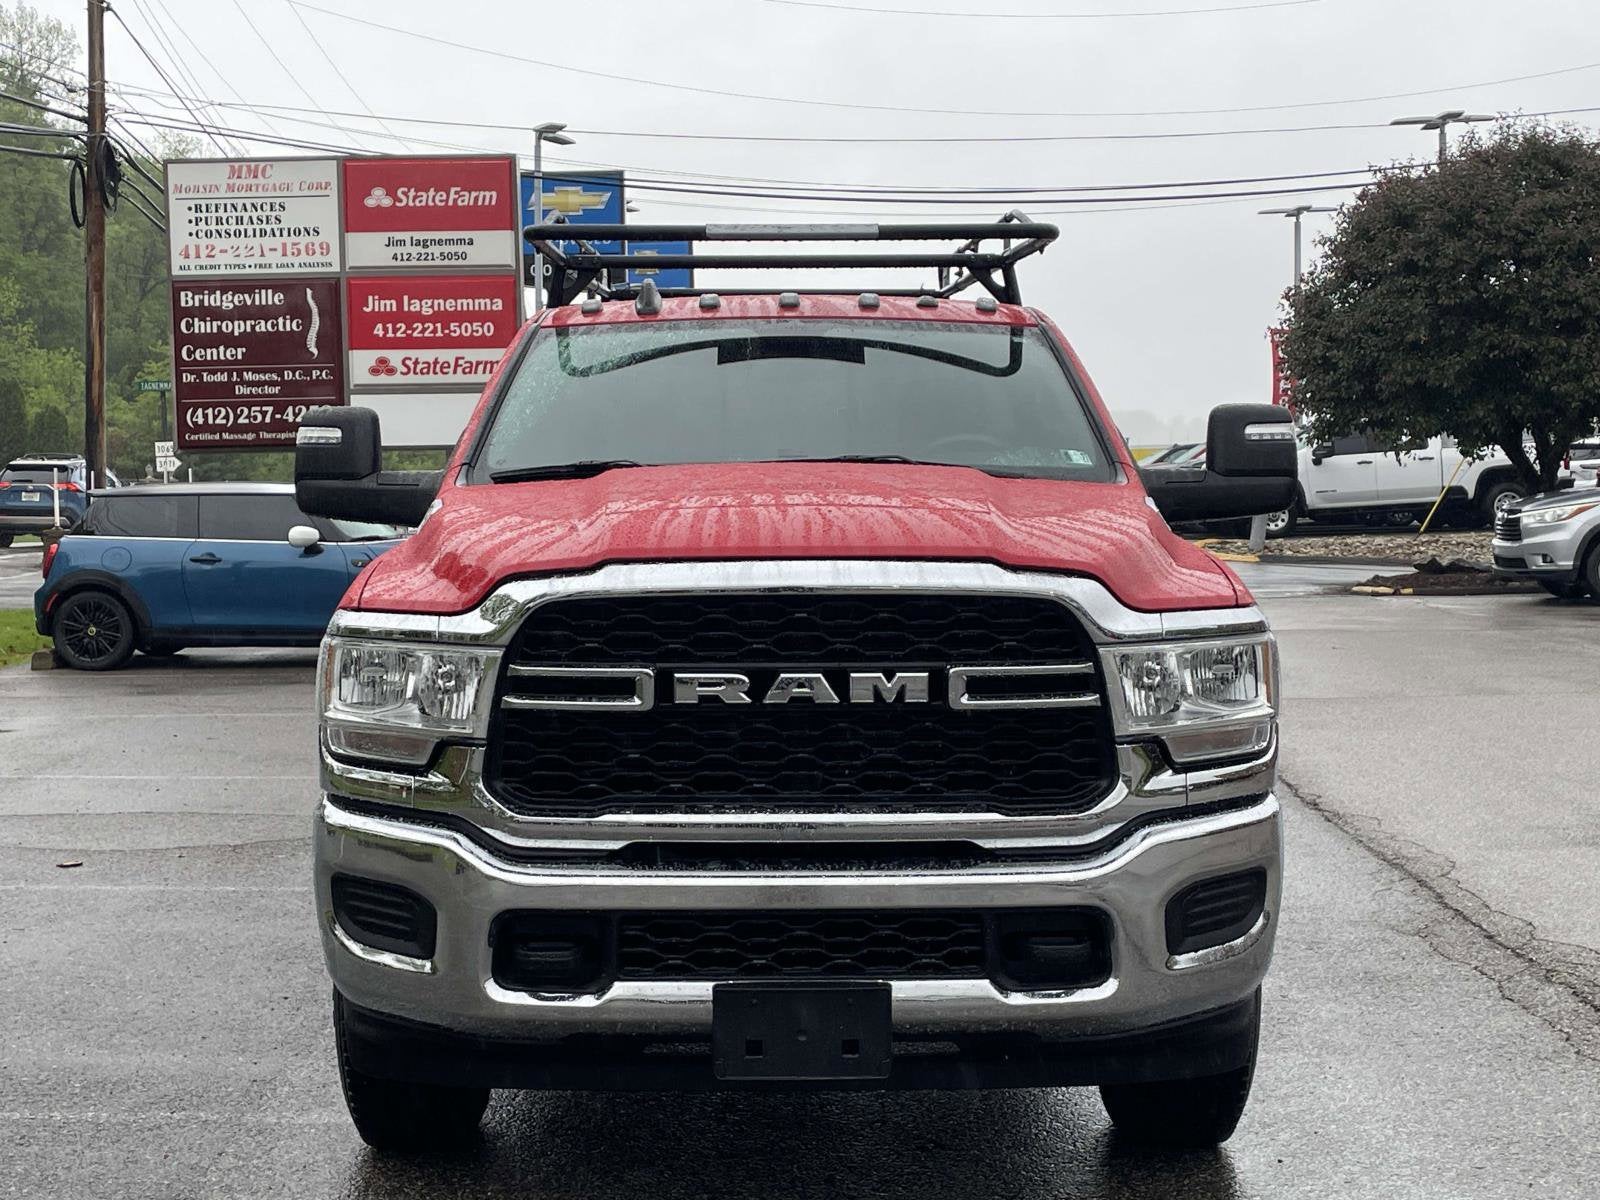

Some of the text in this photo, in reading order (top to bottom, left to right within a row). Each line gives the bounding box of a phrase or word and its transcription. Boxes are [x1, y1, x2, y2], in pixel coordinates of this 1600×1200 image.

[227, 164, 274, 180] MMC
[225, 182, 293, 194] MORTGAGE
[194, 202, 287, 214] REFINANCES
[194, 215, 282, 226] PURCHASES
[195, 226, 320, 239] CONSOLIDATIONS
[384, 236, 474, 249] Jim Iagnemma
[178, 241, 331, 260] 412-221-1569
[391, 251, 468, 262] 412-221-5050
[180, 289, 285, 310] Bridgeville
[362, 295, 503, 315] Jim Iagnemma
[180, 315, 303, 336] Chiropractic
[373, 322, 495, 338] 412-221-5050
[181, 344, 247, 361] Center
[182, 372, 199, 383] Dr.
[201, 371, 228, 382] Todd
[230, 371, 241, 382] J.
[312, 369, 334, 380] P.C.
[235, 384, 281, 395] Director
[185, 432, 220, 441] Certified
[221, 431, 257, 441] Massage
[673, 672, 929, 704] RAM
